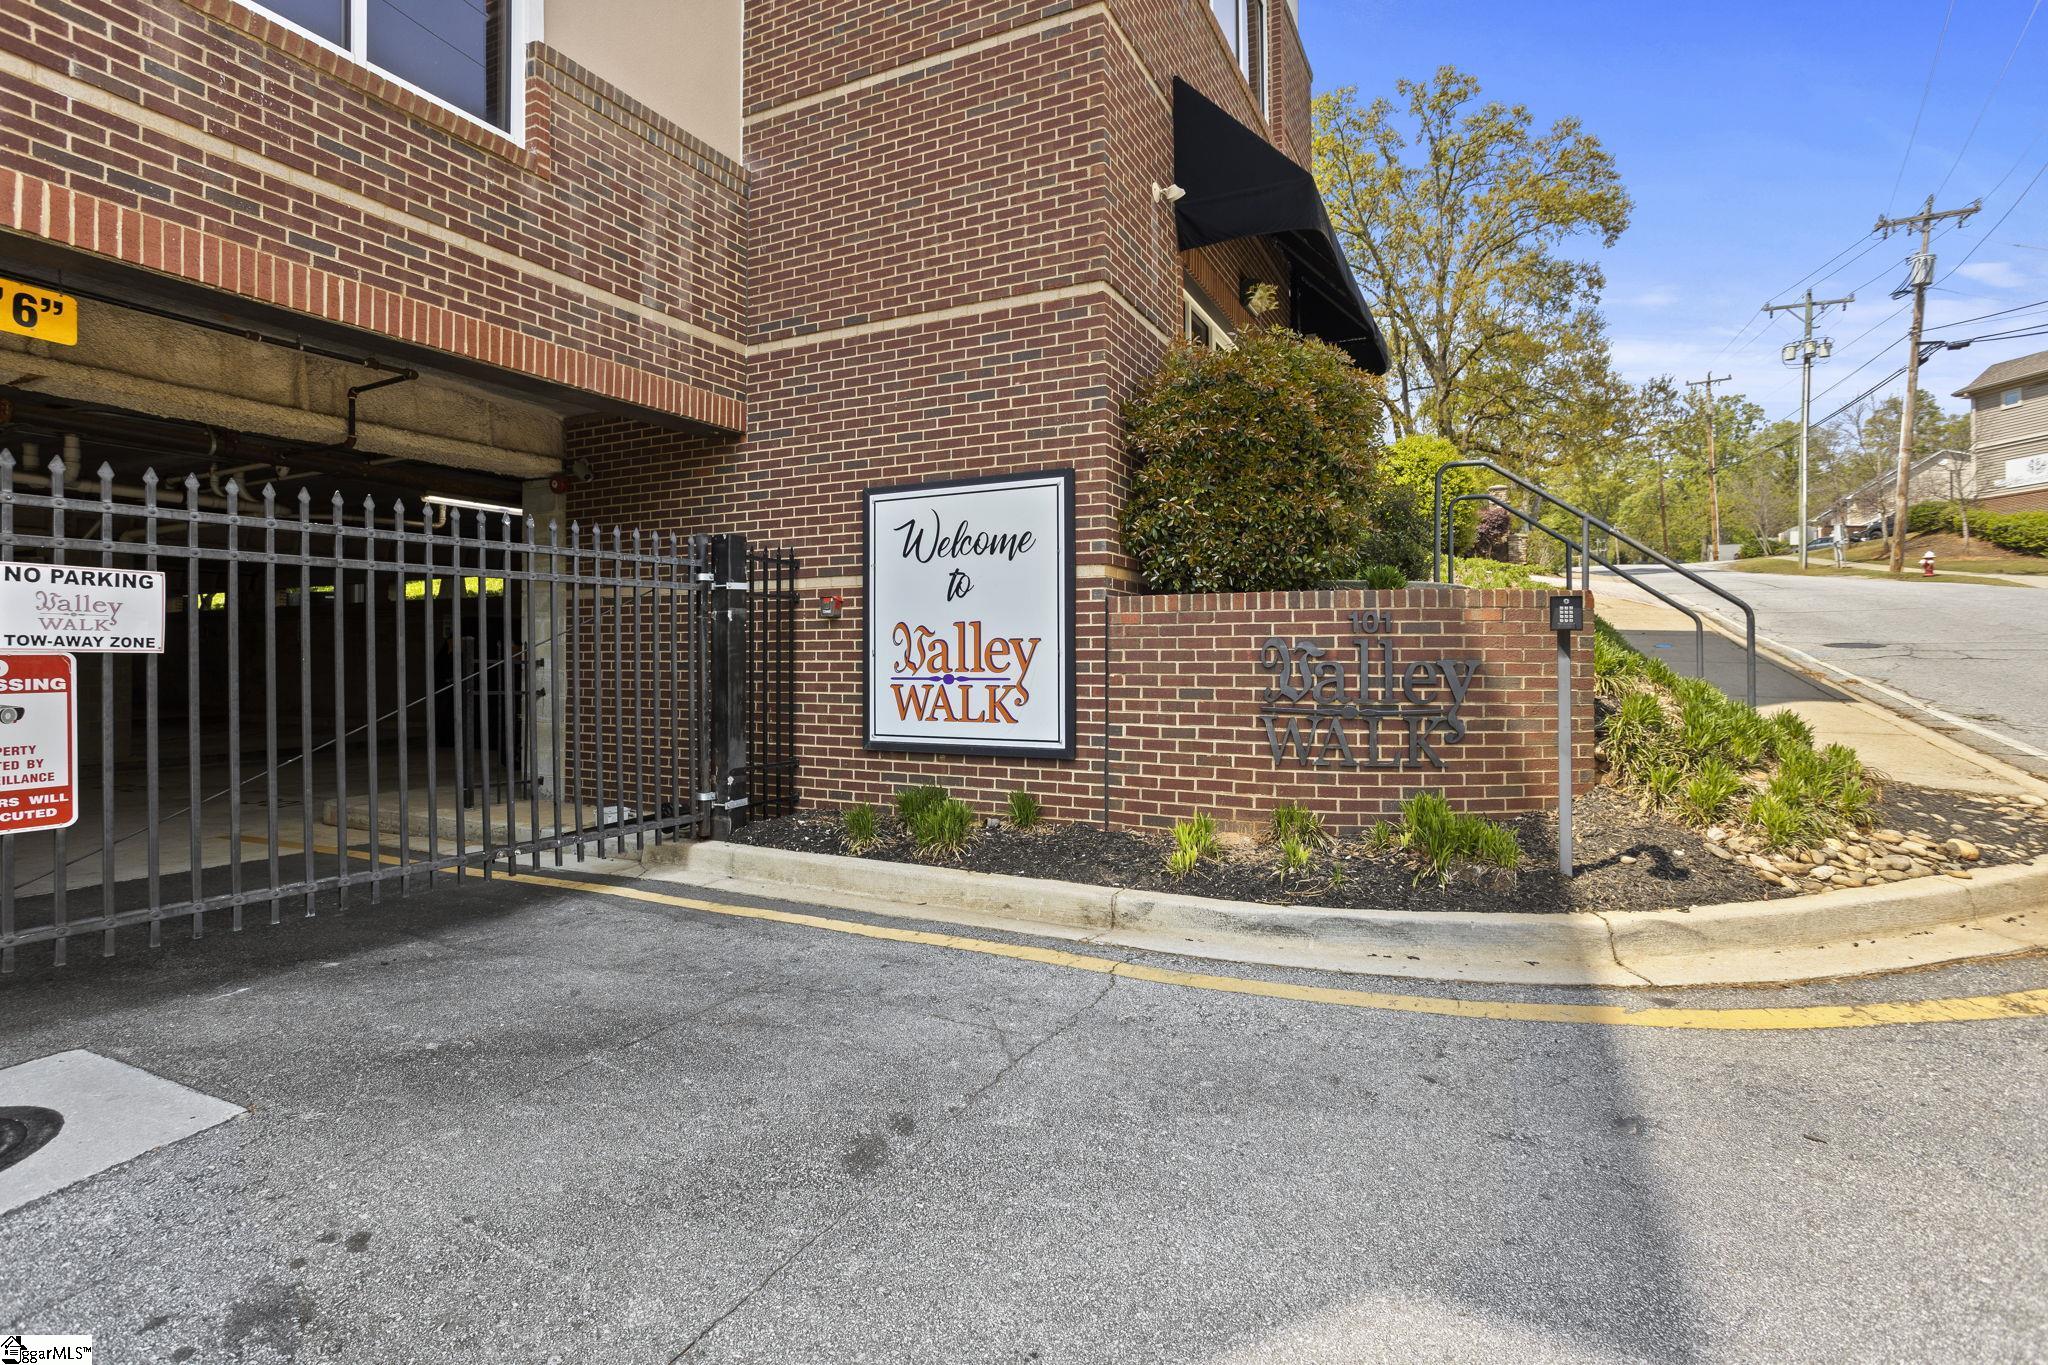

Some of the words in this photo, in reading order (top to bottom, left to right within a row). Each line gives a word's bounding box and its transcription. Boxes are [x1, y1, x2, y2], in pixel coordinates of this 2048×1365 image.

[893, 507, 1037, 564] Welcome
[4, 566, 41, 583] NO
[51, 568, 154, 589] PARKING
[946, 567, 974, 602] to
[35, 590, 123, 626] Valley
[1349, 610, 1393, 634] 101
[38, 617, 111, 632] WALK
[4, 634, 104, 648] TOW-AWAY
[110, 636, 156, 649] ZONE
[892, 620, 1042, 707] Valley
[889, 683, 1019, 724] WALK
[1260, 637, 1482, 745] Valley
[1259, 715, 1449, 769] WALK
[0, 760, 20, 771] ED
[27, 758, 44, 769] BY
[0, 772, 55, 785] ILLANCE
[28, 793, 69, 805] WILL
